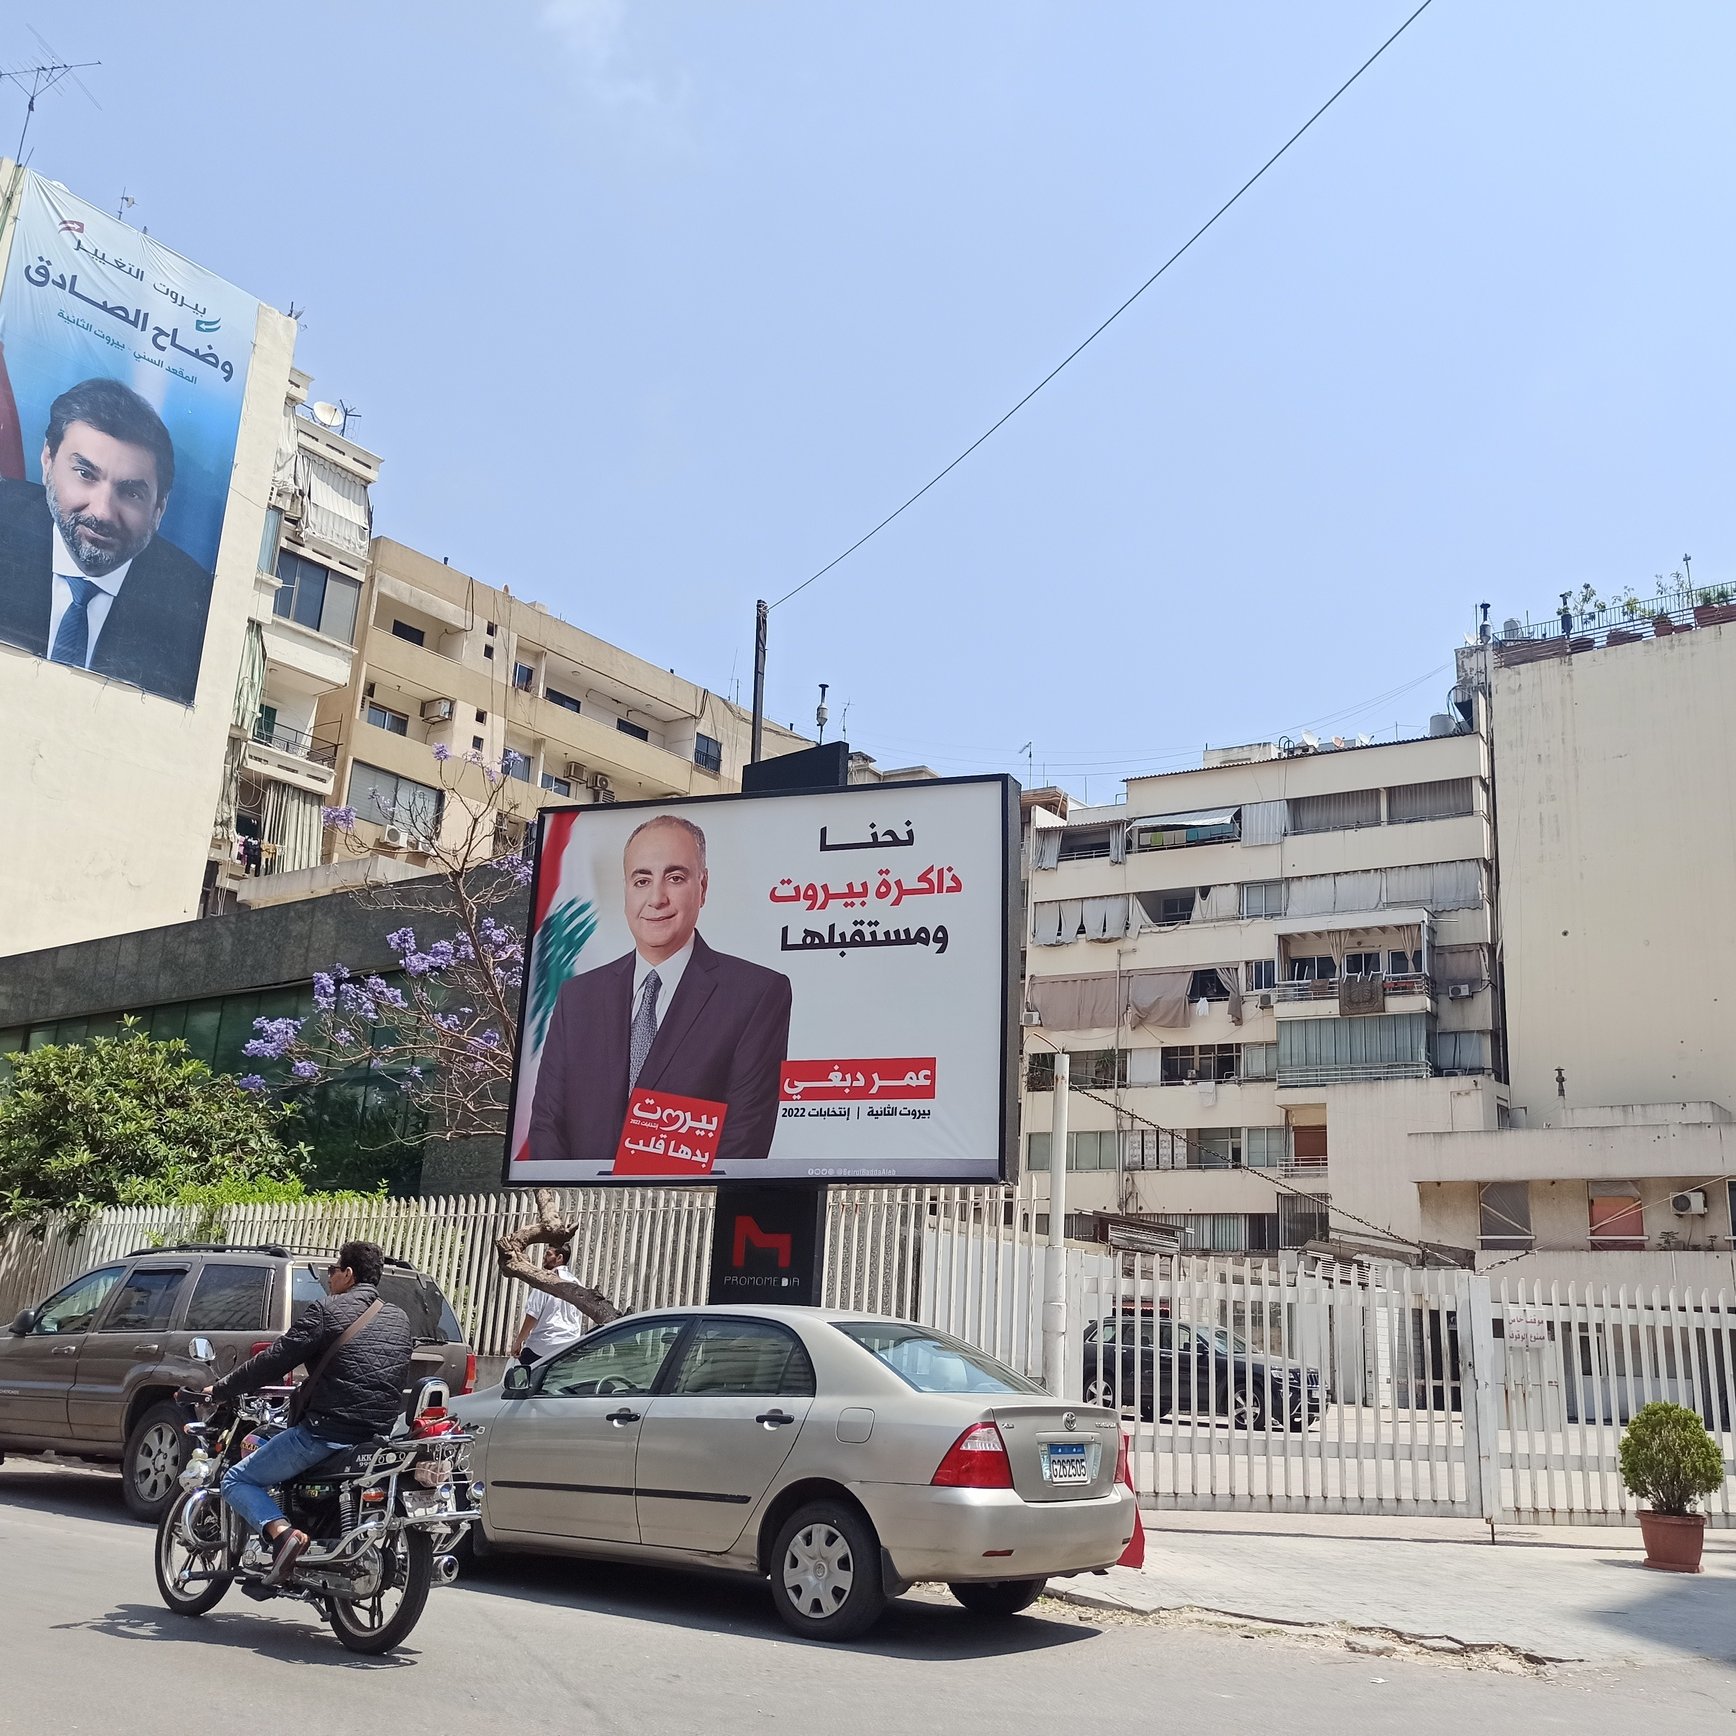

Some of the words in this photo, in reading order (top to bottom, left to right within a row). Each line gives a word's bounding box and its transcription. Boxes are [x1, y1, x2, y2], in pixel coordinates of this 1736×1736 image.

[74, 239, 145, 282] التغيير
[24, 256, 149, 332] الصادق
[152, 281, 207, 317] بيروت
[57, 308, 93, 333] الثانية
[93, 328, 126, 352] بيروت
[133, 351, 164, 369] السني
[151, 325, 234, 382] وضاح
[165, 366, 198, 385] المقعد
[819, 819, 915, 852] نحنا
[769, 877, 869, 911] بيروت
[875, 864, 963, 907] ذاكرة
[781, 919, 949, 958] ومستقبلها
[783, 1064, 865, 1100] دبغي
[868, 1069, 932, 1094] عمر
[633, 1097, 718, 1138] بيروت
[781, 1107, 806, 1118] 2022
[867, 1104, 898, 1119] الثانية
[898, 1106, 931, 1120] بيروت
[624, 1133, 667, 1155] قلب
[668, 1140, 709, 1168] بدها
[723, 1276, 800, 1287] PROMOMEDIA
[1052, 1459, 1087, 1478] G262505
